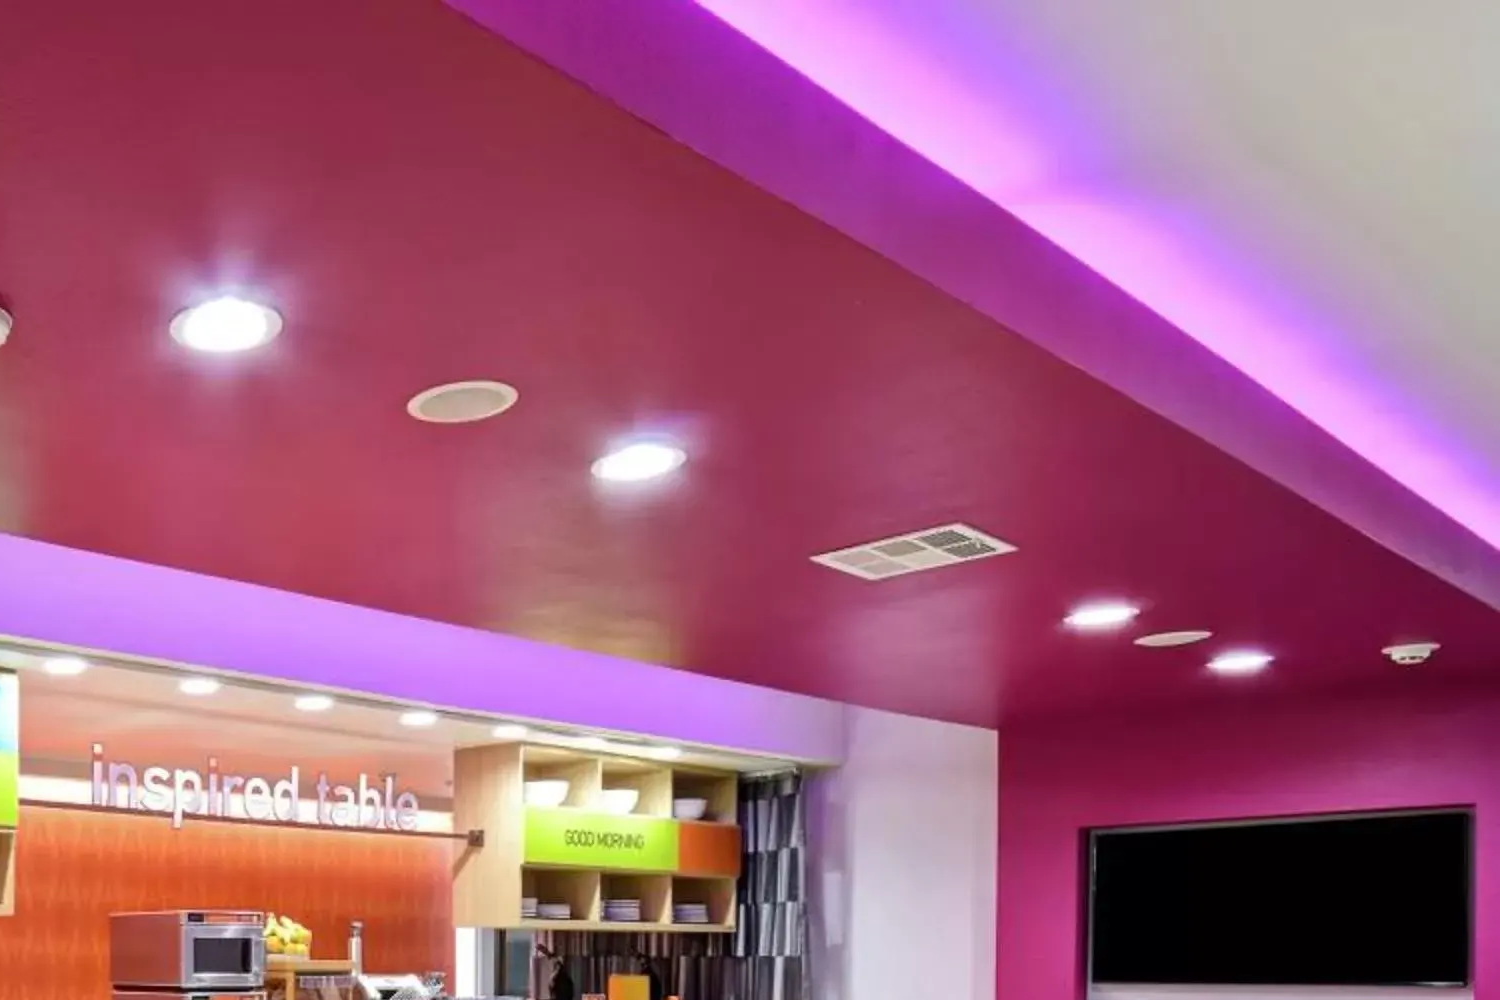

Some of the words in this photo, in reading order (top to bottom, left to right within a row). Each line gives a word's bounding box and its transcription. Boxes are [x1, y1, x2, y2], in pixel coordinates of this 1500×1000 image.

[91, 742, 300, 829] inspired
[316, 772, 420, 831] table
[564, 829, 595, 848] GOOD
[597, 831, 645, 850] MORNING
